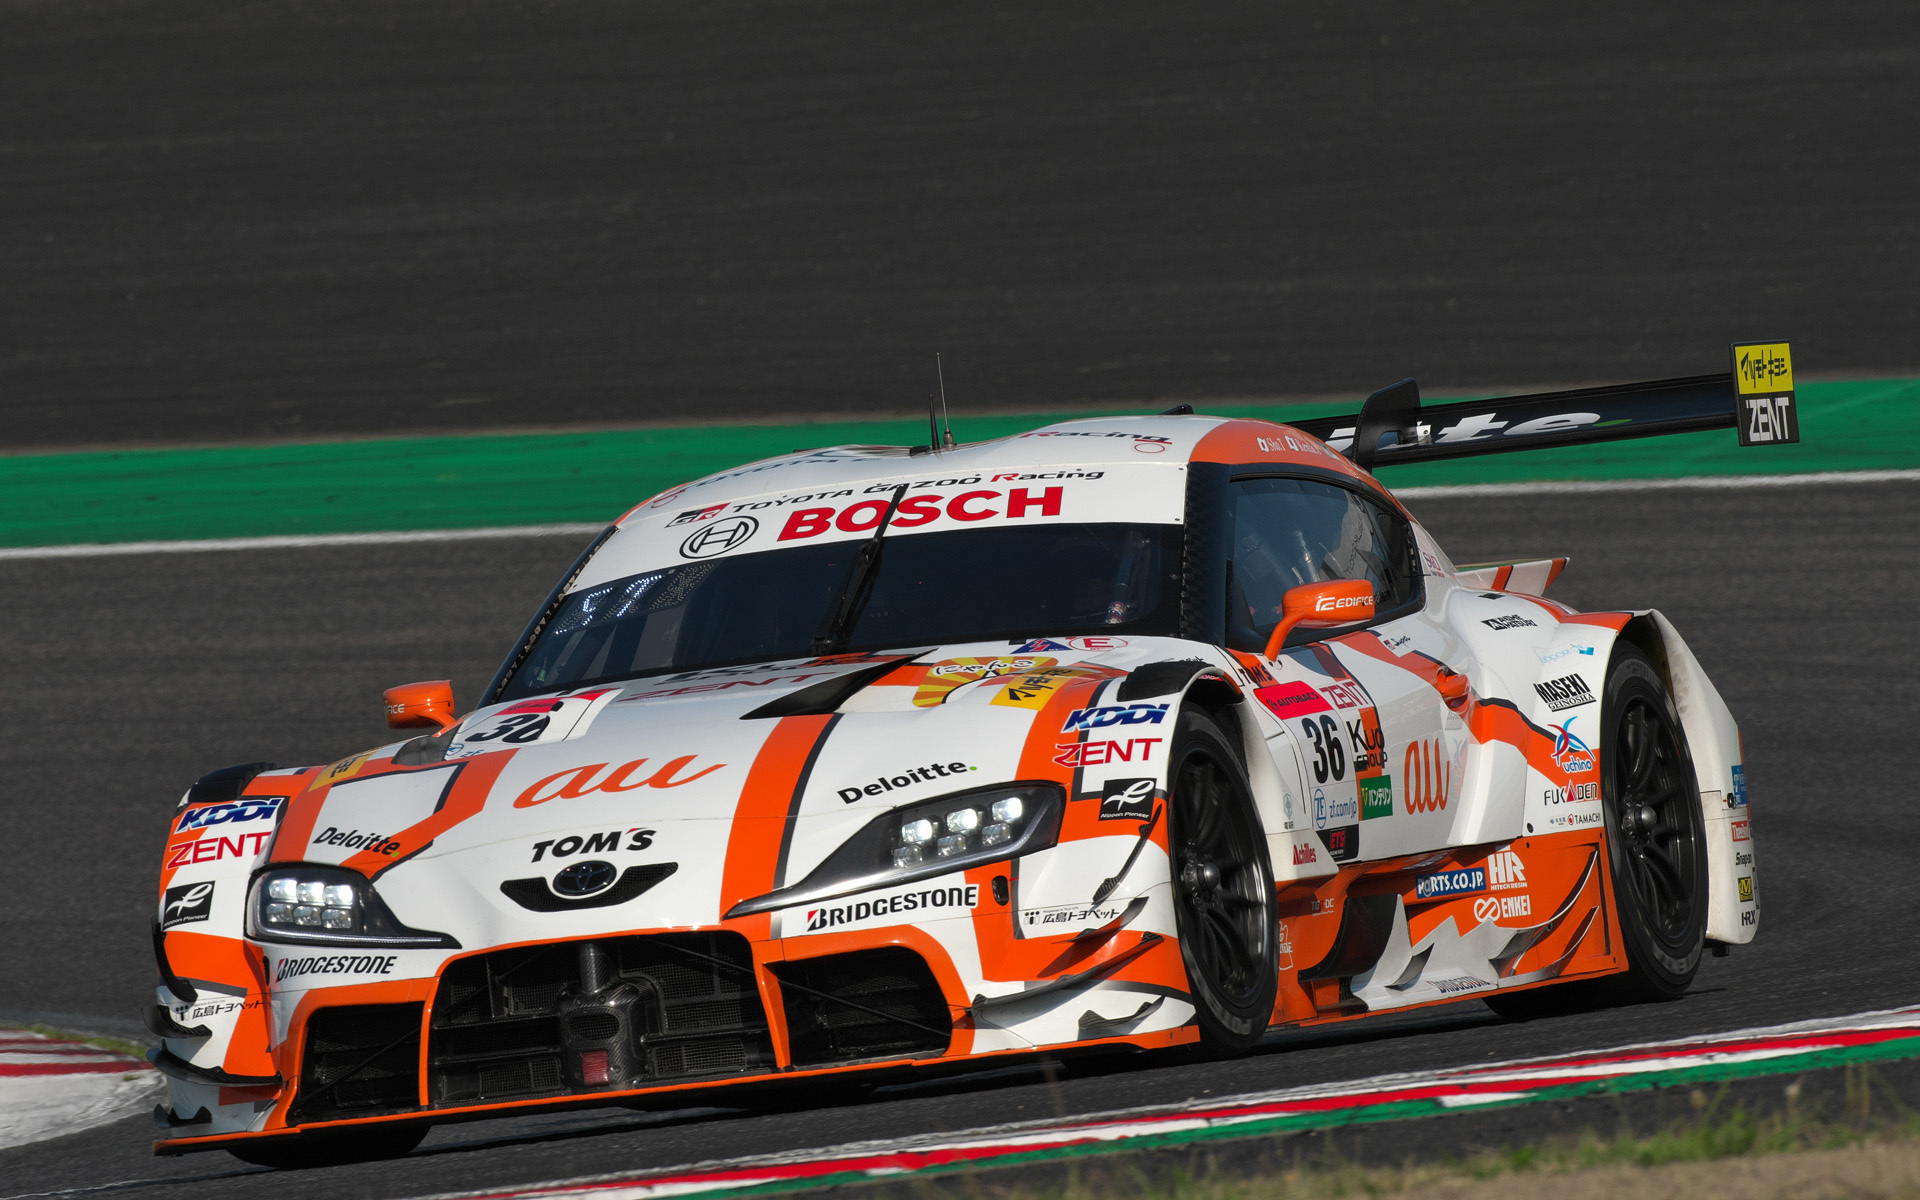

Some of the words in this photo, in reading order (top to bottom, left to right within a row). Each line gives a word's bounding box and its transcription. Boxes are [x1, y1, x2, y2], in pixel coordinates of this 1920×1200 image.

[1746, 397, 1789, 442] ZENT
[733, 489, 853, 513] TOYOTA
[863, 474, 981, 494] GAZOO
[990, 469, 1104, 483] Racing
[777, 486, 1063, 542] BOSCH
[1336, 595, 1373, 609] EDIFICE
[616, 672, 837, 703] ZENT
[1238, 662, 1273, 685] TOM'S
[1533, 673, 1591, 703] MASEKI
[1276, 691, 1320, 707] AUTOBACS
[1319, 681, 1369, 709] ZENT
[1547, 694, 1596, 710] GEINOSHA
[465, 701, 564, 744] 36
[1062, 704, 1171, 733] KDDI
[1054, 738, 1163, 768] ZENT
[1301, 714, 1346, 784] 36
[1355, 751, 1388, 771] GROUP
[1562, 755, 1593, 772] uchino
[513, 754, 728, 809] au
[836, 758, 979, 805] Deloitte.
[1404, 737, 1451, 815] au
[175, 798, 284, 834] KDDI
[167, 831, 273, 869] ZENT
[312, 826, 401, 858] Deloitte.
[531, 827, 657, 863] TOM'S
[1293, 843, 1317, 865] Achilles
[1331, 831, 1345, 848] ETS
[1488, 851, 1526, 884] HR
[807, 886, 977, 932] BRIDGESTONE
[1042, 908, 1120, 924] 広島トヨペット
[1501, 895, 1531, 918] ENKEI
[1741, 910, 1756, 926] HRX
[275, 955, 398, 984] BRIDGESTONE
[192, 1000, 264, 1019] 広島トヨペット
